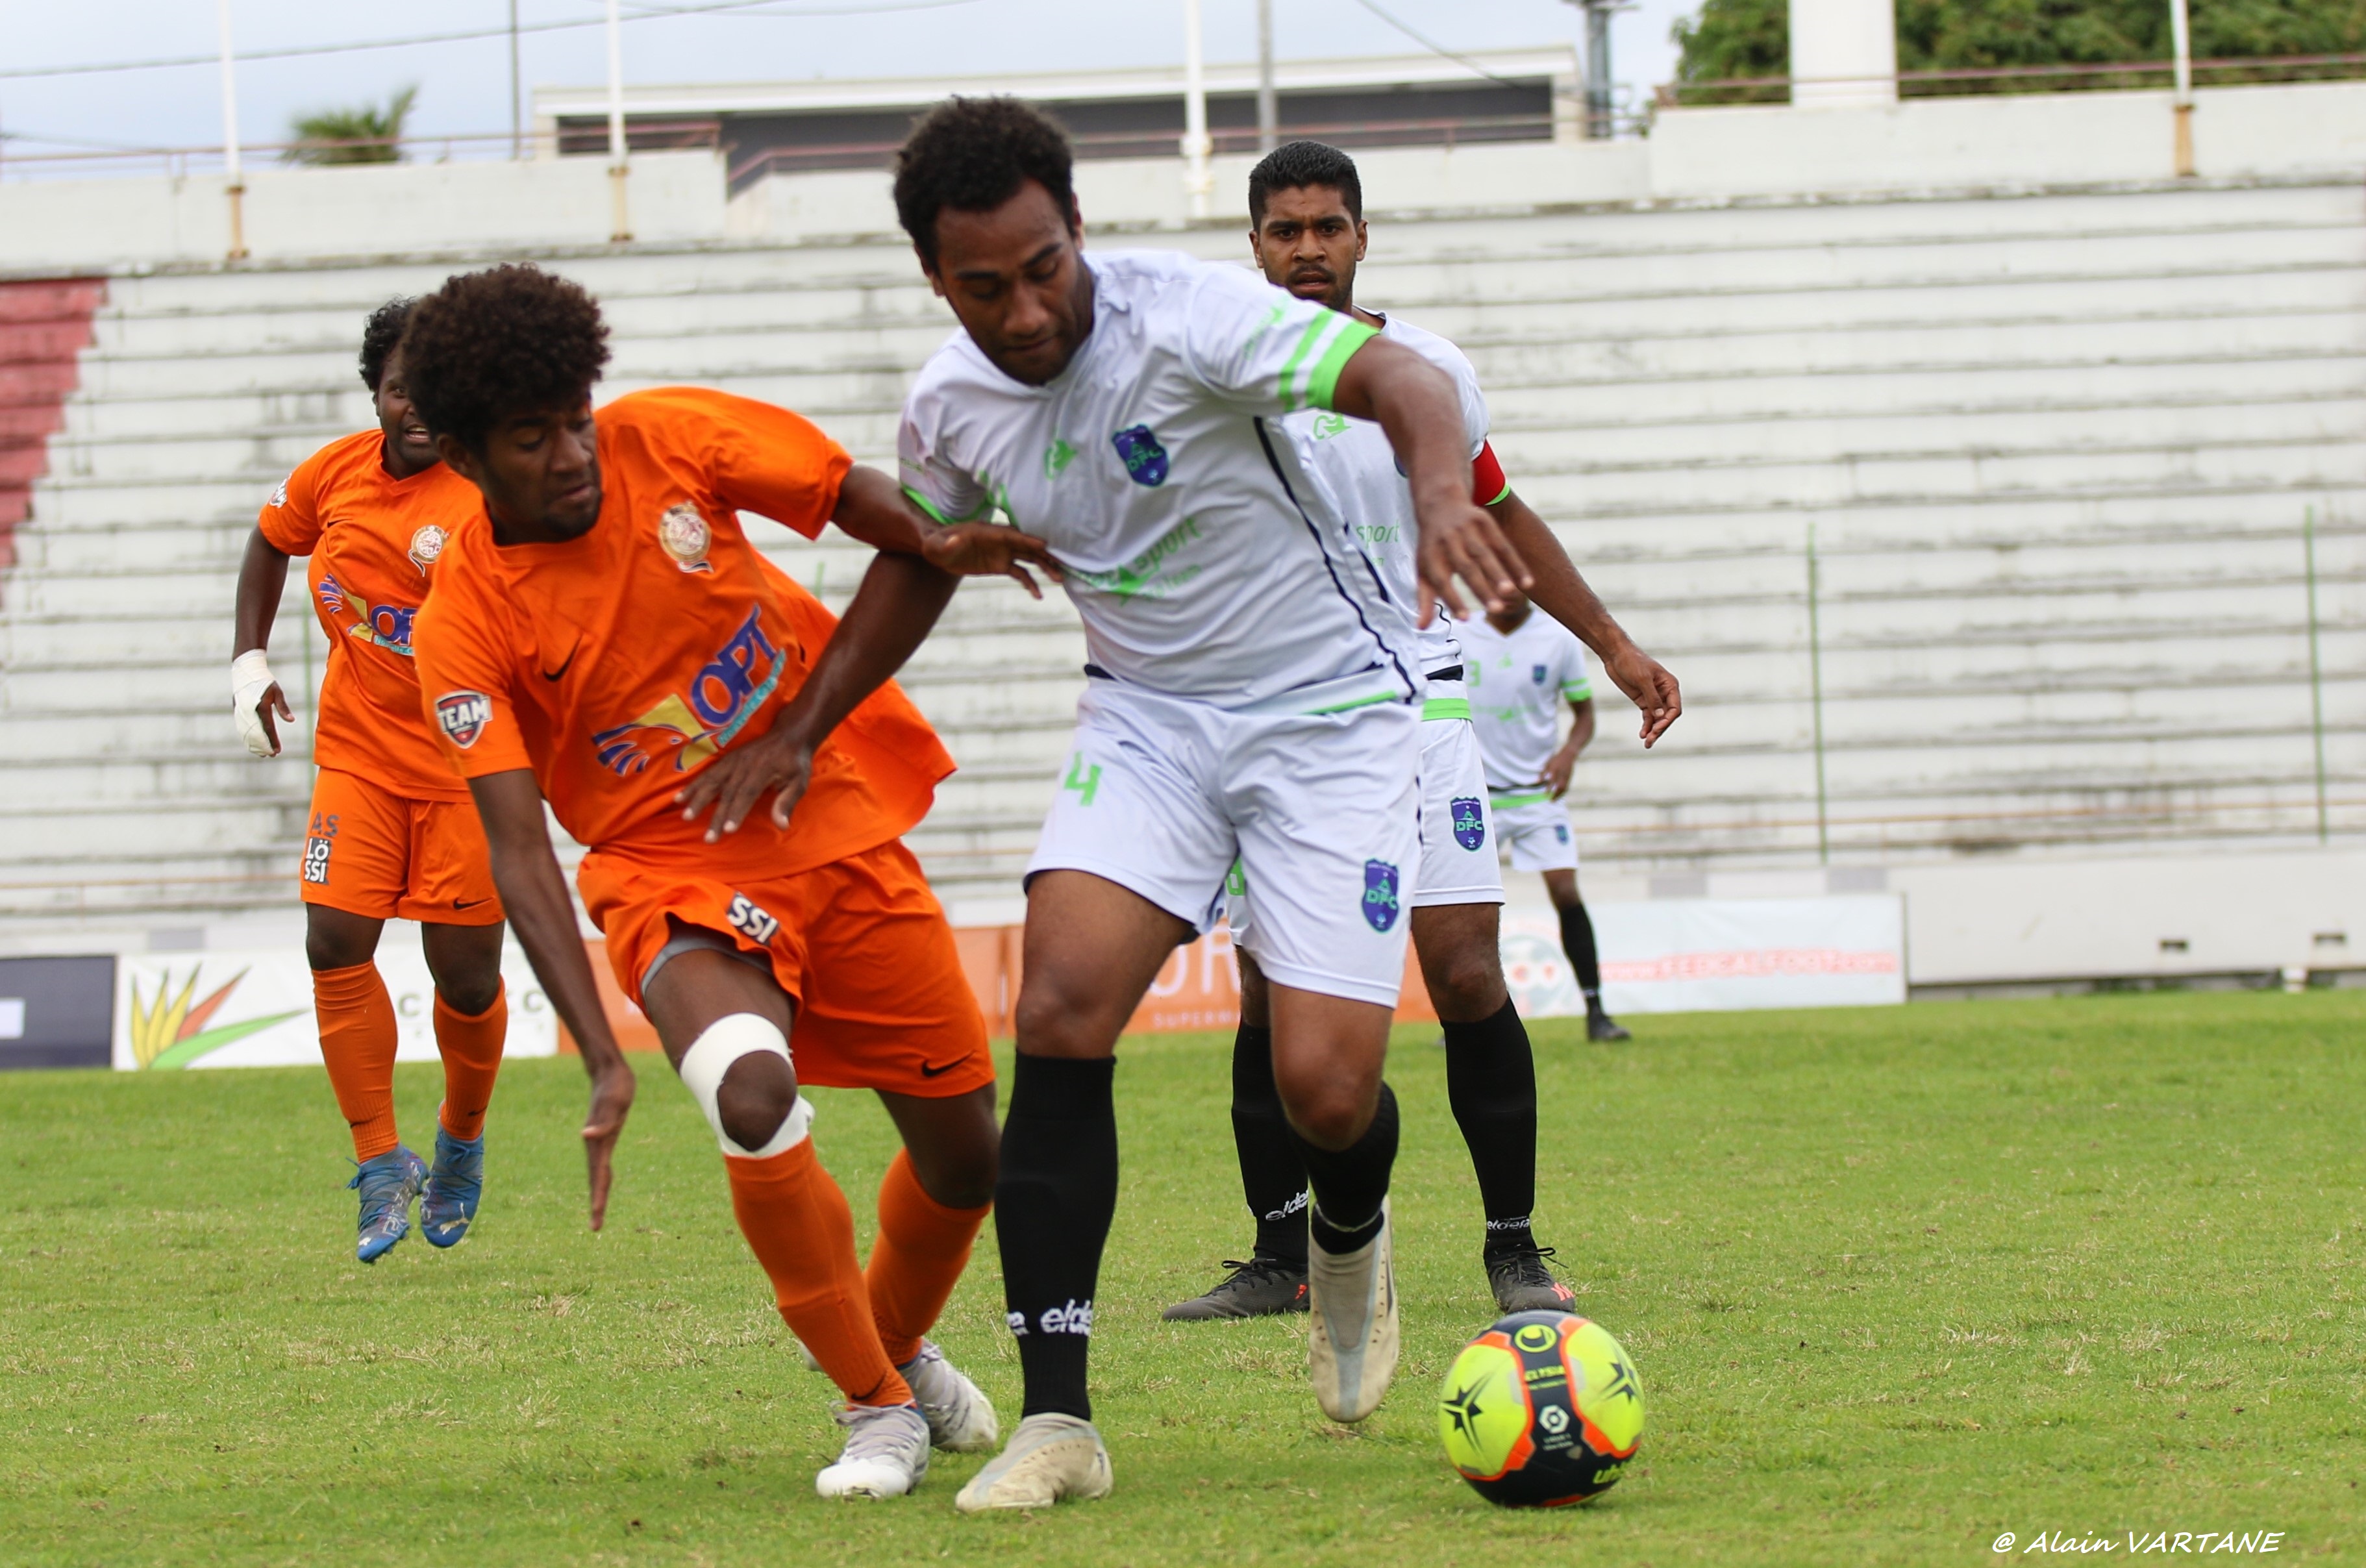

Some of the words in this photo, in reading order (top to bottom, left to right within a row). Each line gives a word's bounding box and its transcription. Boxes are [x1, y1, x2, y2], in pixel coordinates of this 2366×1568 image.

[1356, 520, 1400, 549] sport
[369, 604, 418, 646] OP
[691, 603, 777, 727] OPT
[437, 697, 492, 730] TEAM
[1064, 751, 1102, 806] 4
[311, 811, 340, 837] AS
[1456, 821, 1483, 832] DFC
[306, 838, 329, 861] LÖ
[305, 860, 326, 882] SSI
[1365, 888, 1398, 910] DFC
[728, 896, 778, 943] SSI
